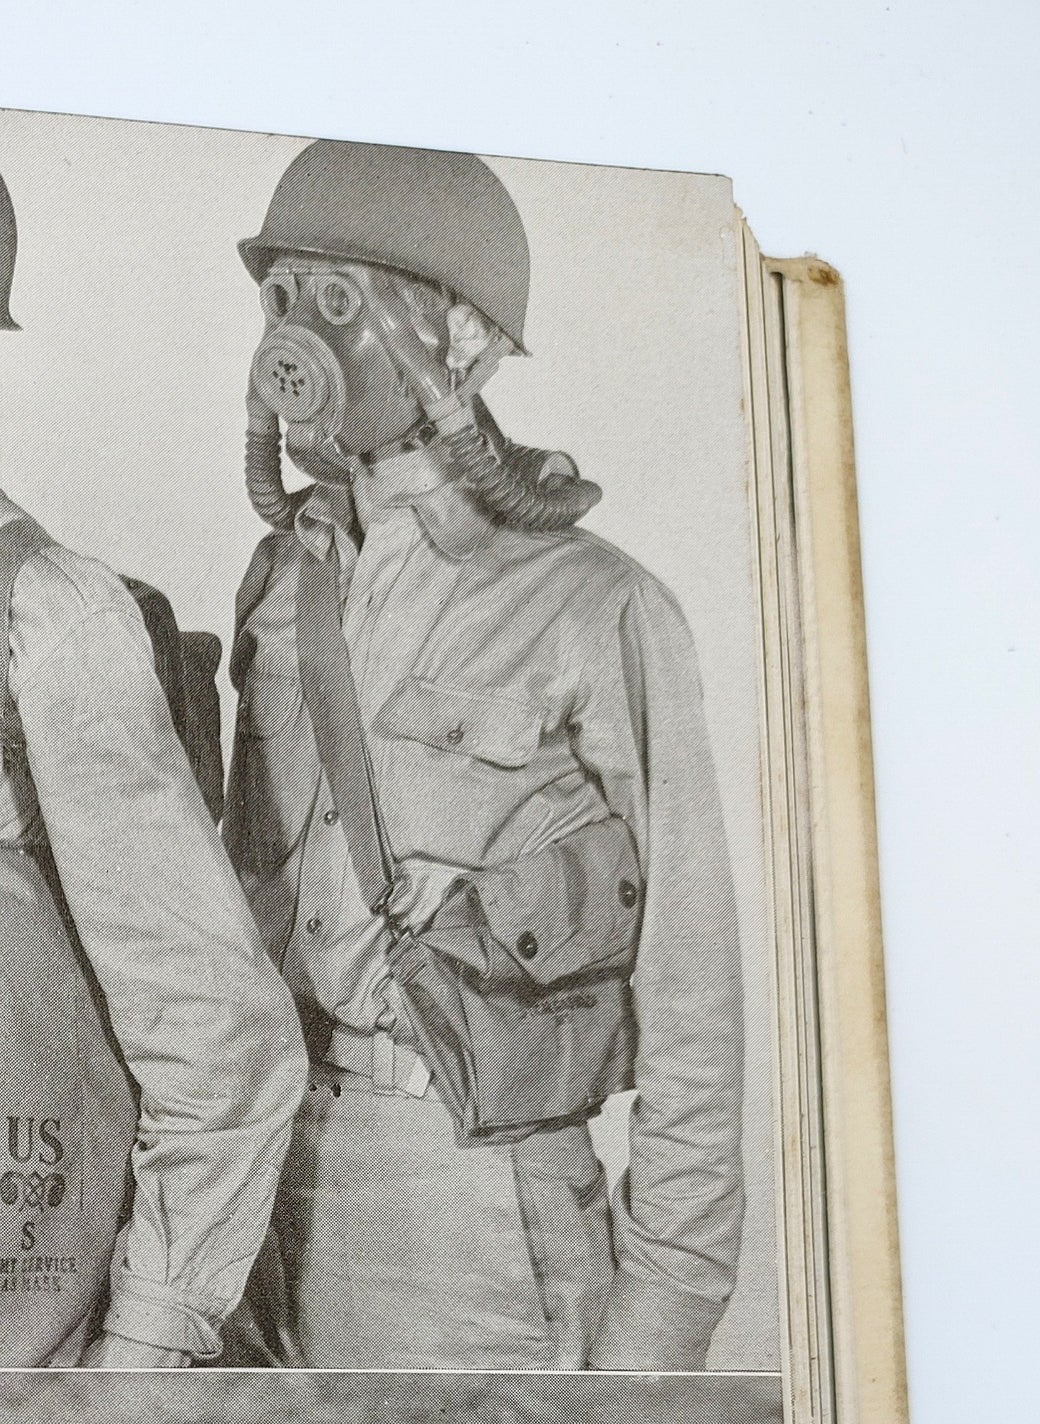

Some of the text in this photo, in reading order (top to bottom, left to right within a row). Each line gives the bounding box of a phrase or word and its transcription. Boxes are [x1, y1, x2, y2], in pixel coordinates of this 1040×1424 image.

[6, 1115, 64, 1166] US
[20, 1220, 36, 1251] S
[21, 1256, 78, 1274] SERVICE
